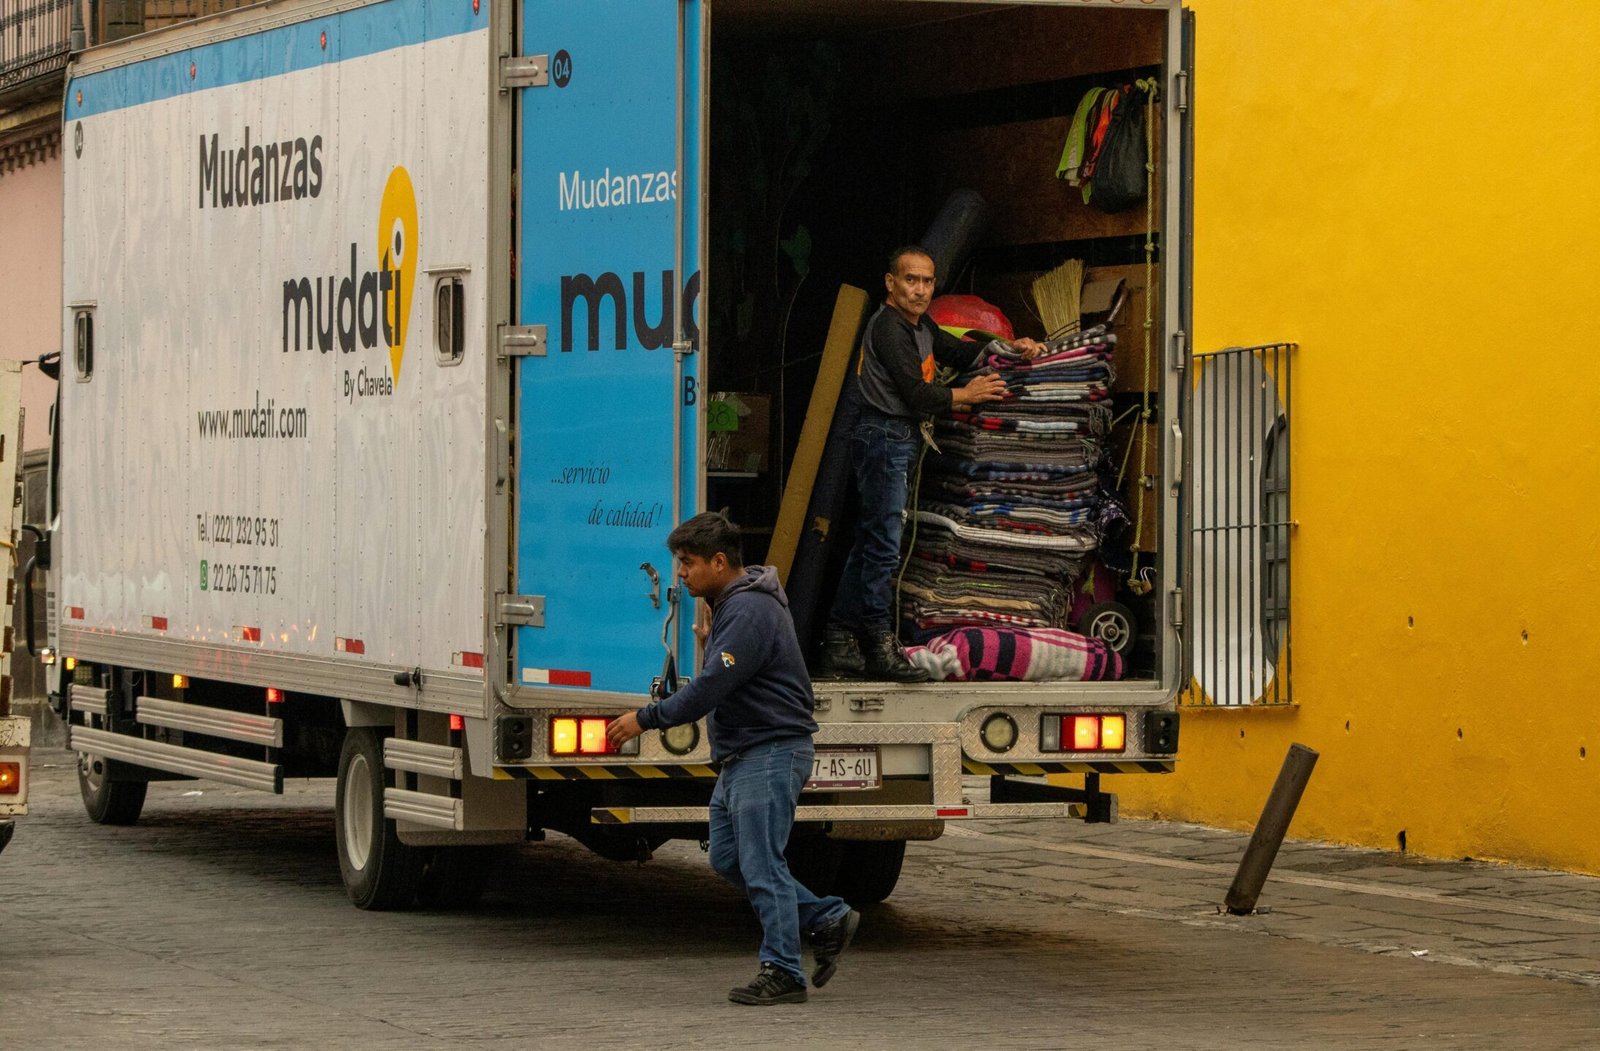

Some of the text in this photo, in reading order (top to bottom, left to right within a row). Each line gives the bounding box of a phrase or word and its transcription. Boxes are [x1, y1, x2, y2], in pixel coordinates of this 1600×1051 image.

[555, 58, 570, 80] 04
[199, 126, 323, 209] Mudanzas
[282, 230, 402, 354] mudati
[344, 365, 393, 405] By Chavela
[684, 375, 700, 406] B
[198, 389, 307, 439] www.mudati.com
[197, 511, 279, 549] Tel. (222) 232 95 31
[588, 499, 604, 526] de
[213, 563, 276, 595] 22 26 75 71 75
